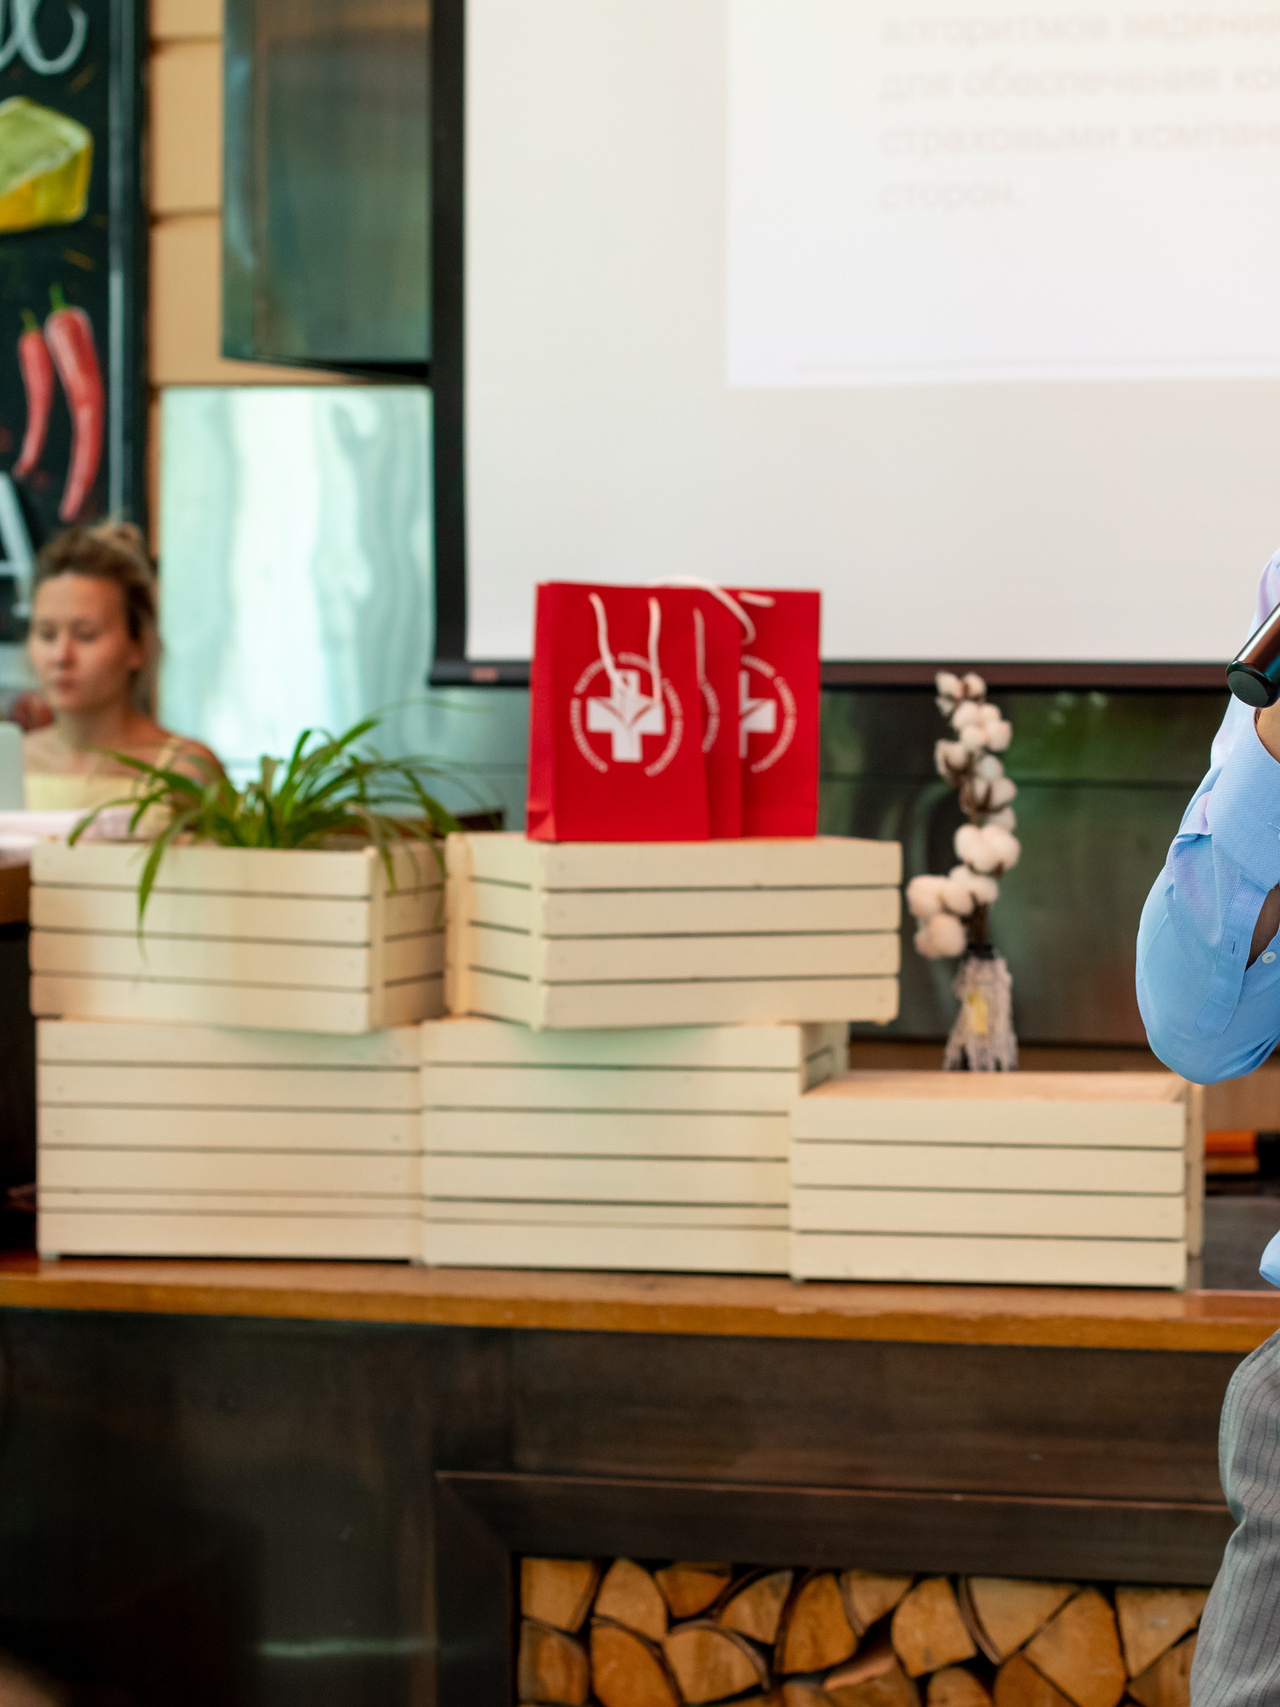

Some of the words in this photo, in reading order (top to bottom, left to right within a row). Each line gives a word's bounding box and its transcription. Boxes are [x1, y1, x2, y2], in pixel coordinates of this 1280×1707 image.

[879, 14, 1111, 49] алгоритмов
[879, 68, 952, 102] для
[963, 62, 1221, 98] обеспечения
[879, 121, 1119, 161] страховыми
